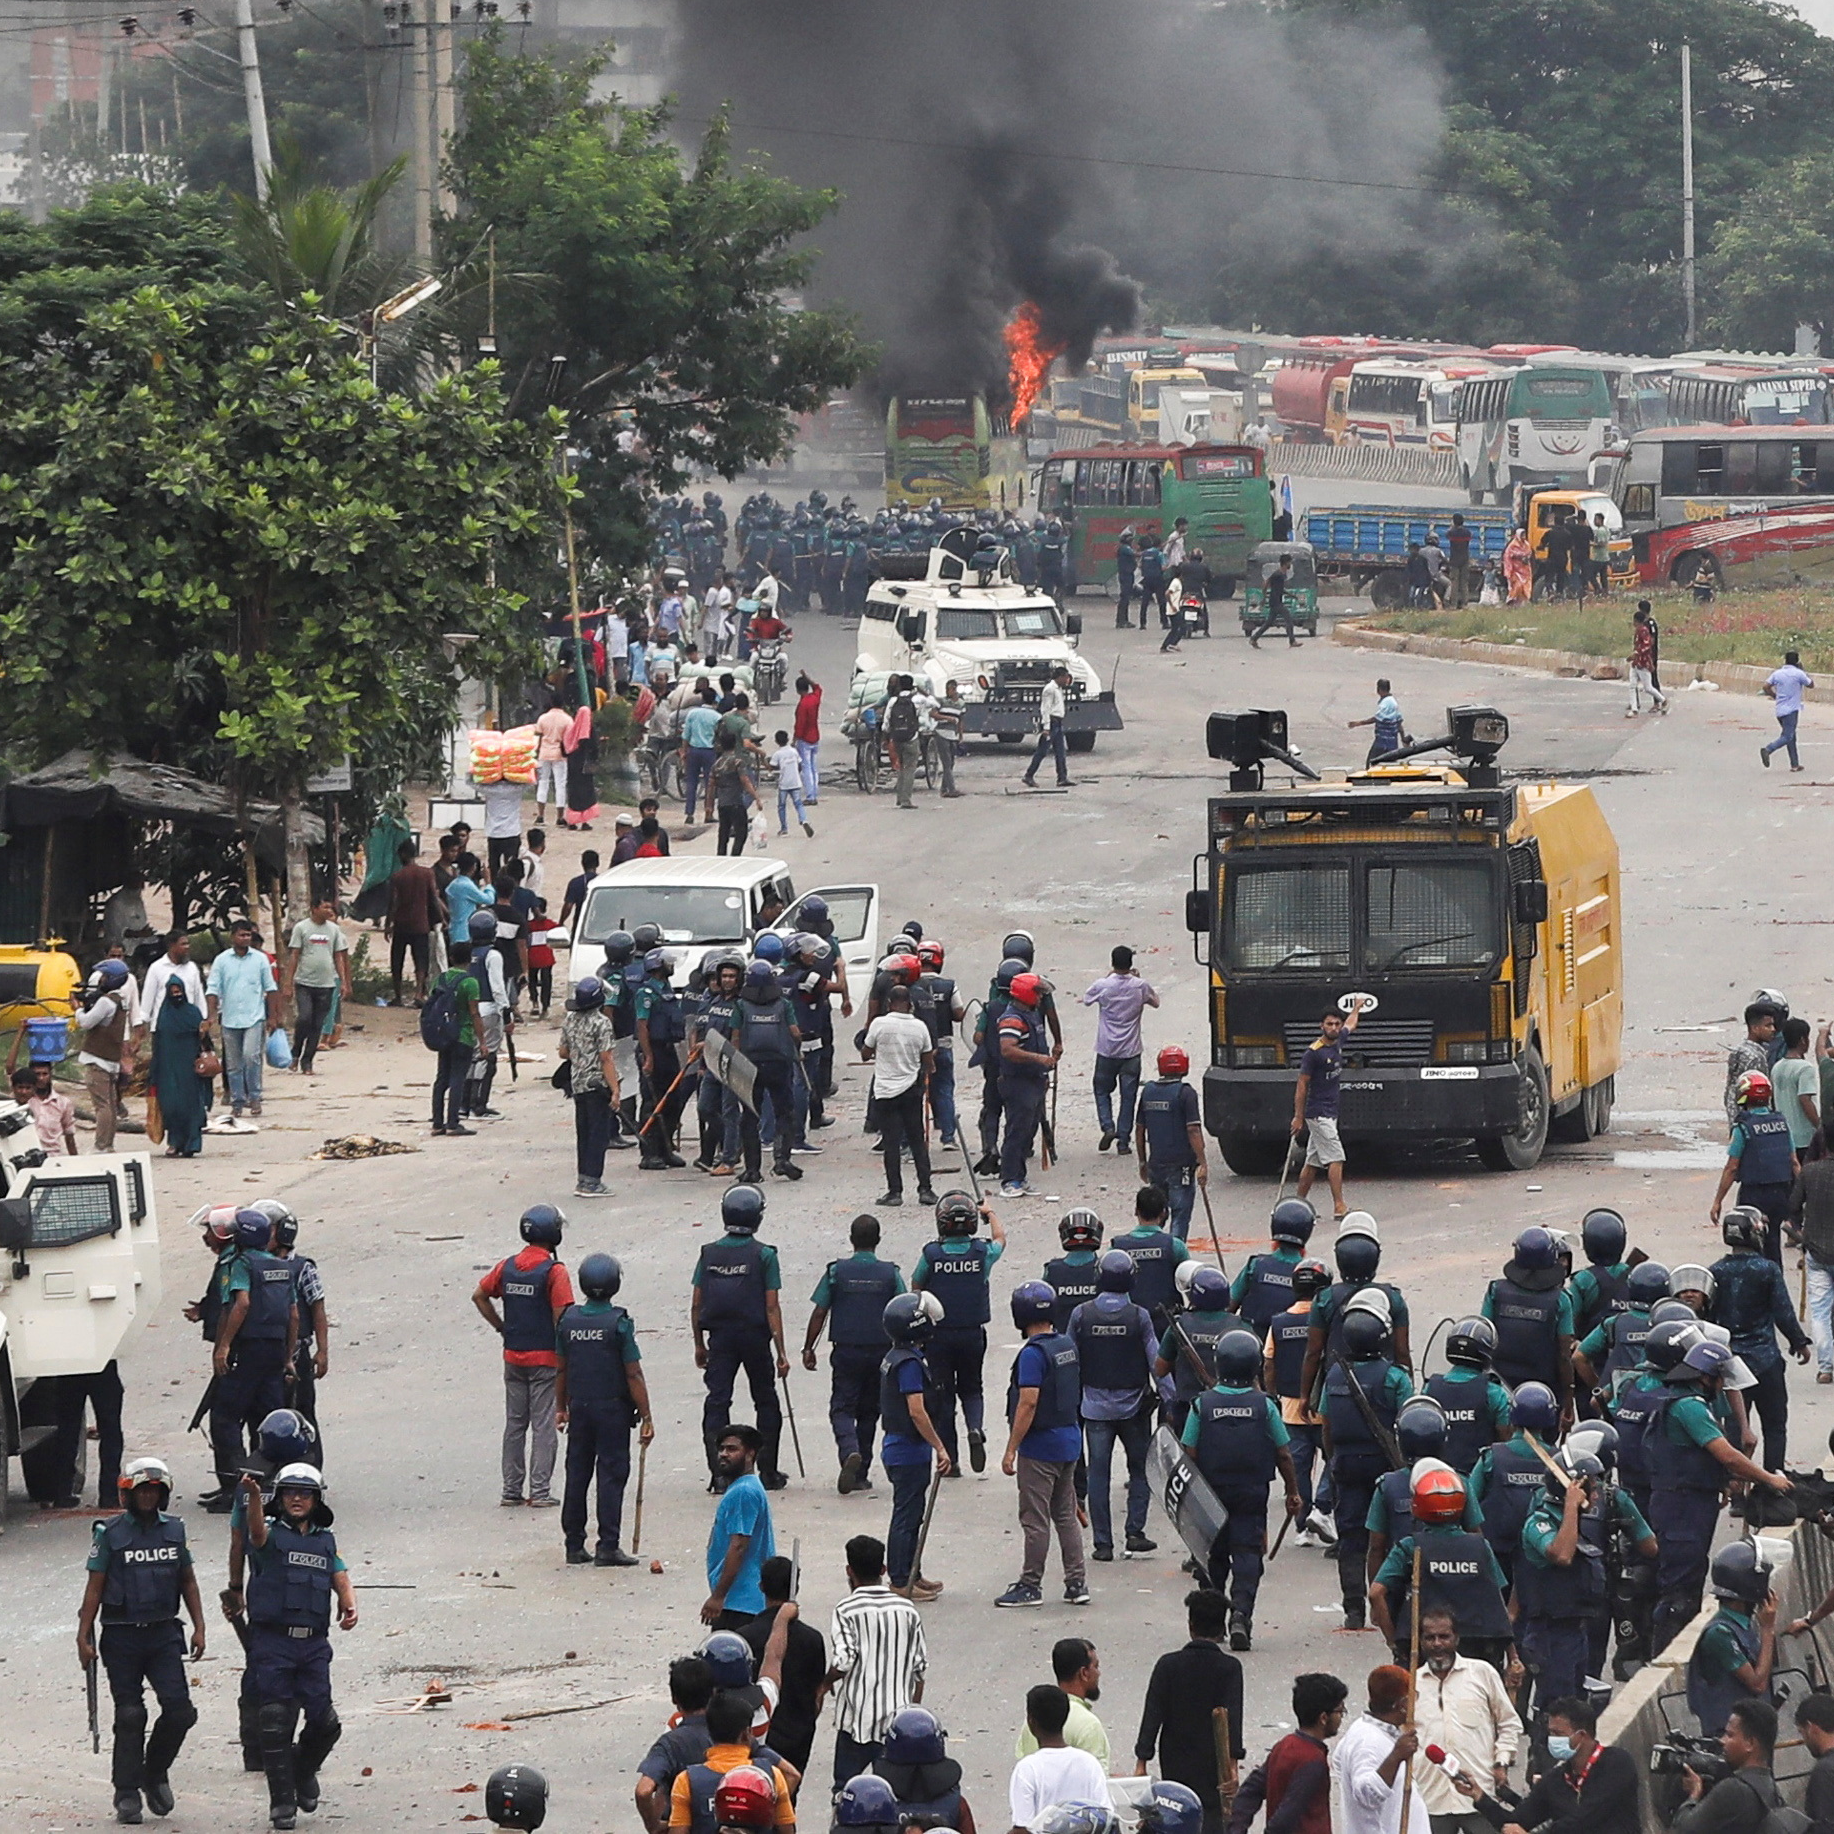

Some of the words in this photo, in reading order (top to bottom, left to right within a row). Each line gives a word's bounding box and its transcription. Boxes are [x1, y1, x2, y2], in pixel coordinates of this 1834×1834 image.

[1789, 379, 1817, 392] SUPER
[1342, 998, 1374, 1009] JIO
[1753, 1121, 1788, 1135] POLICE
[934, 1260, 981, 1274] POLICE
[1057, 1285, 1097, 1297] POLICE
[569, 1329, 604, 1341] POLICE
[1444, 1409, 1475, 1422] OLICE
[124, 1547, 179, 1564] POLICE
[291, 1553, 325, 1567] POLICE
[1429, 1561, 1479, 1574] POLICE
[1156, 1795, 1184, 1813] POLICE
